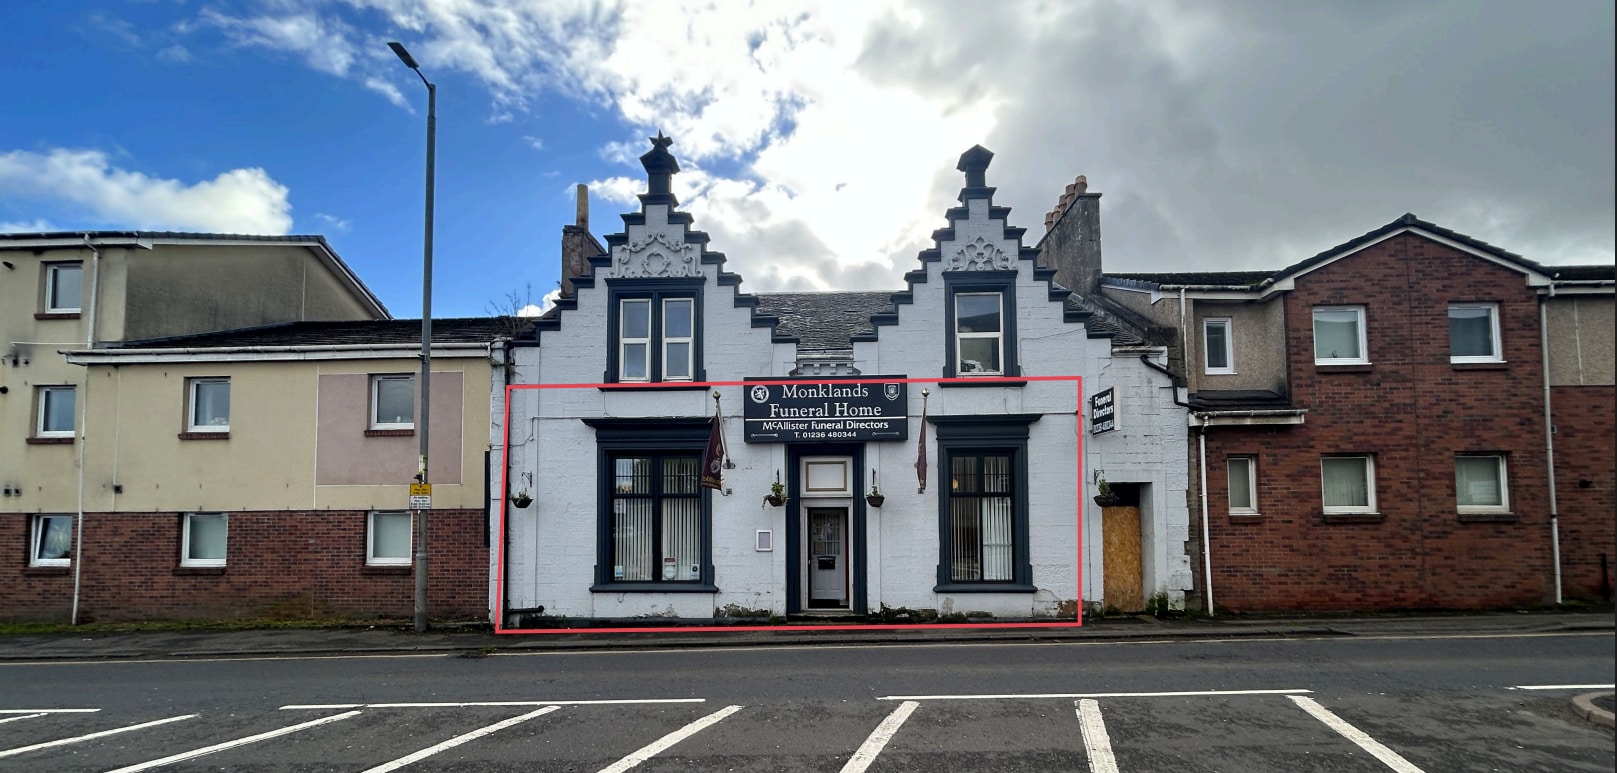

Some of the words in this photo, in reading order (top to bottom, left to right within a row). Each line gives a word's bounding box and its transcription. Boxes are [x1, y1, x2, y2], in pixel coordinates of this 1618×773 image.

[781, 383, 869, 398] Monklands
[1095, 391, 1111, 407] Funeral
[769, 403, 829, 418] Funeral
[834, 402, 882, 417] Home
[1093, 405, 1113, 419] Directors
[762, 421, 809, 430] McAllister
[811, 421, 844, 430] Funeral
[846, 420, 889, 429] Directors
